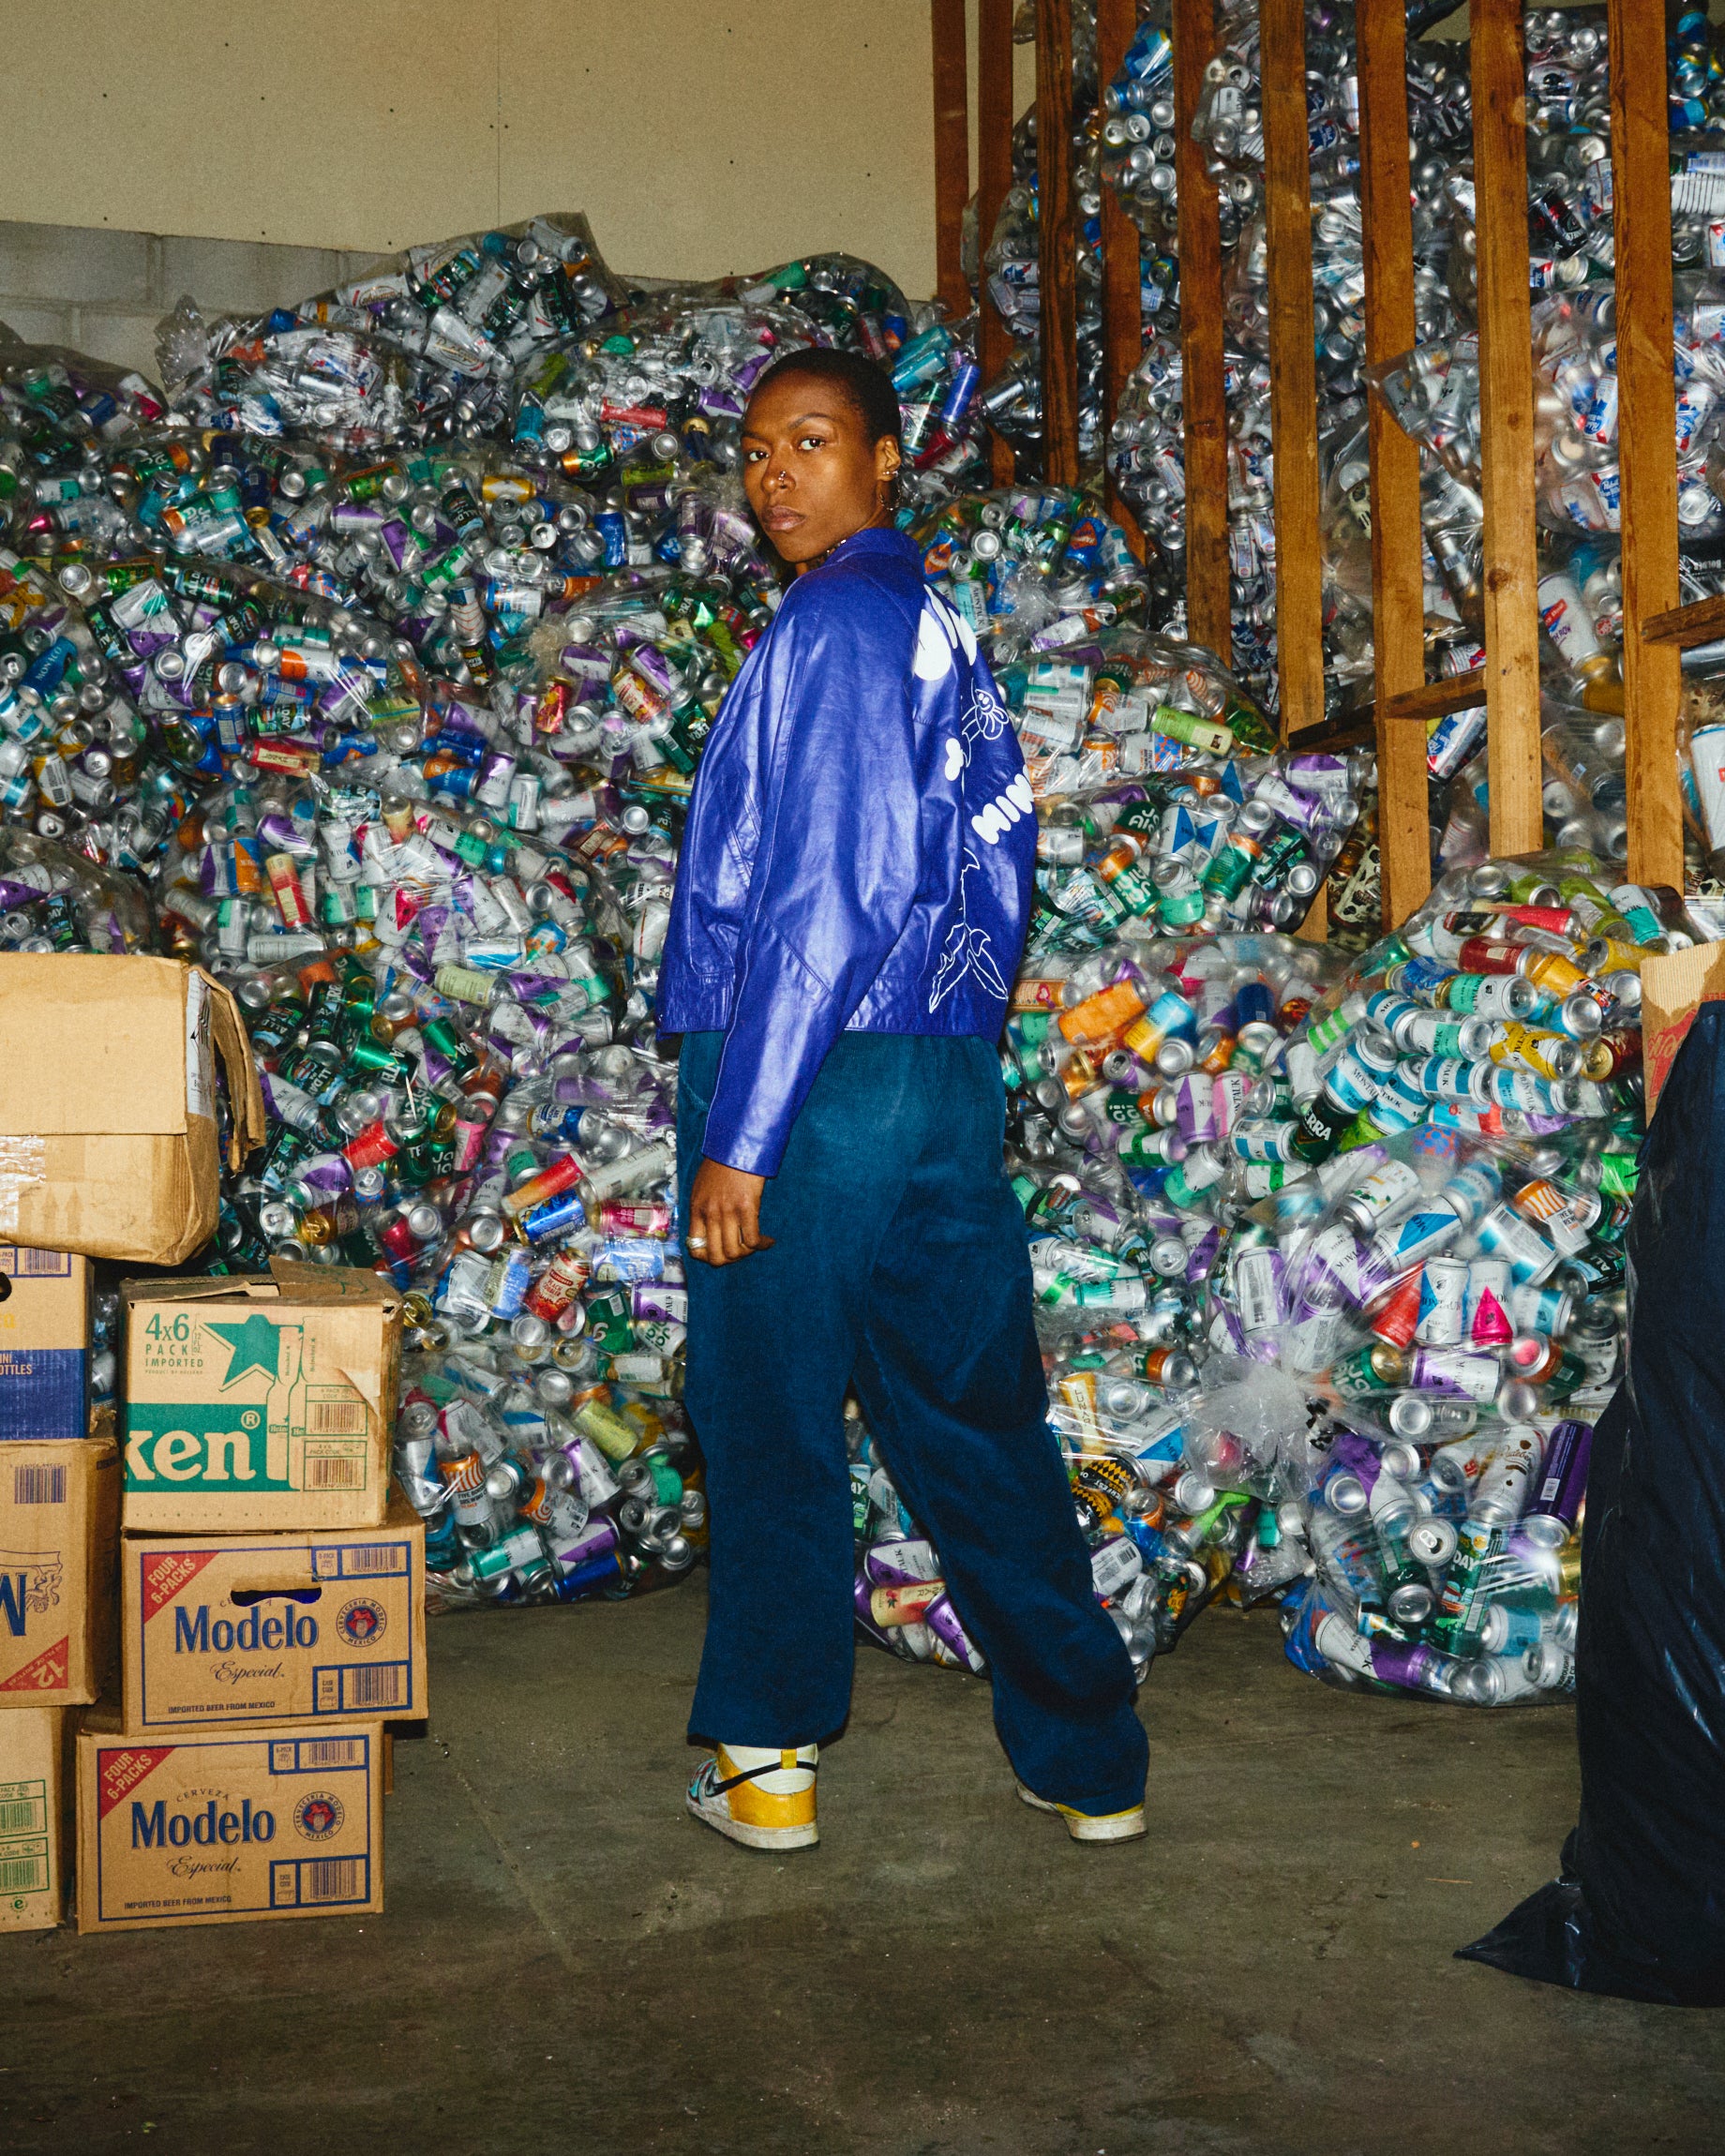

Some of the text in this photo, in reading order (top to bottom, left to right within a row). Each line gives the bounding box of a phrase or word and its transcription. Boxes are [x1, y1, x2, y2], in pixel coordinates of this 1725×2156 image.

[35, 646, 62, 681] MONACO
[145, 1313, 189, 1341] 4x6
[145, 1343, 188, 1355] PACK
[145, 1358, 203, 1368] IMPORTED
[147, 1556, 178, 1586] FOUR
[151, 1558, 196, 1604] 6-PACKS
[174, 1604, 319, 1654] Modelo
[338, 1599, 383, 1635] CERVECERIA MODELO
[347, 1635, 377, 1645] MEXICO
[32, 1660, 66, 1688] 12
[169, 1700, 276, 1714] IMPORTED BEER FROM MEXICO
[103, 1752, 134, 1782] FOUR
[107, 1754, 153, 1800] 6-PACKS
[176, 1788, 230, 1803] CERVEZA
[131, 1798, 276, 1850] Modelo
[296, 1793, 341, 1829] CERVECERIA MODELO
[305, 1829, 334, 1840] MEXICO
[125, 1895, 232, 1909] IMPORTED BEER FROM MEXICO
